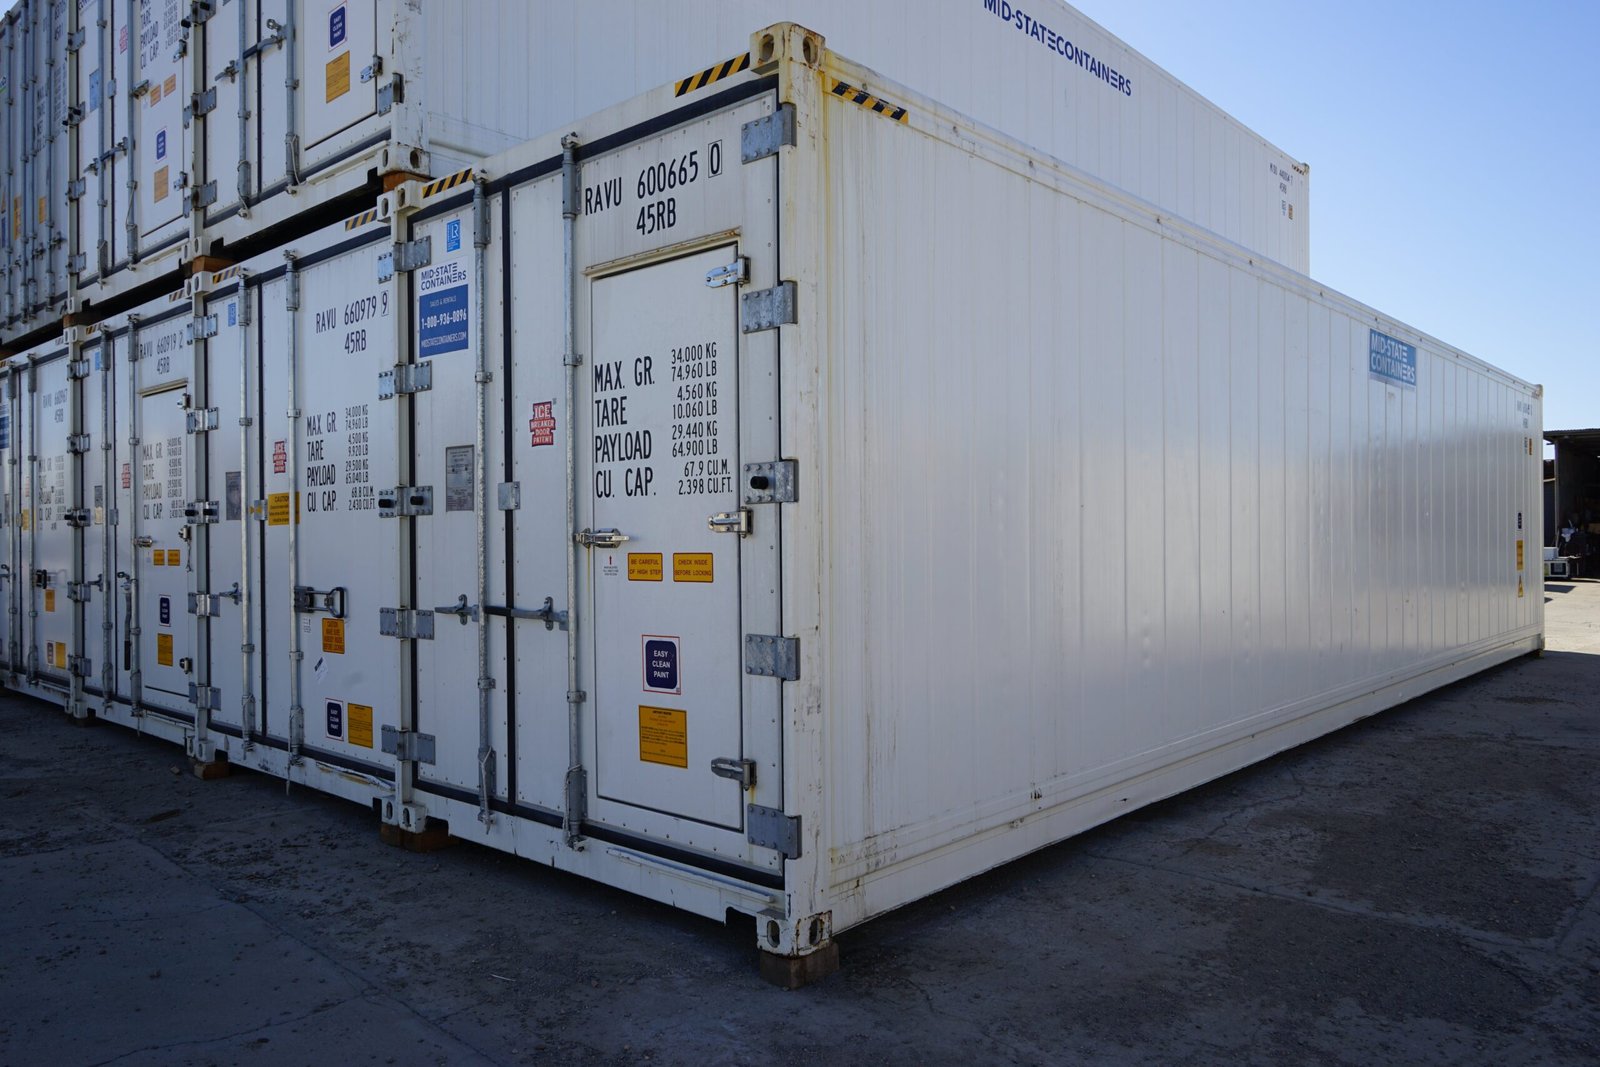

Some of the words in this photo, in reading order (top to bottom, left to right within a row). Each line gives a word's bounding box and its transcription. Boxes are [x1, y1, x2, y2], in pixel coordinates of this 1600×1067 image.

[585, 177, 622, 216] RAVU
[637, 150, 699, 199] 600665
[710, 142, 721, 175] 0
[636, 197, 677, 235] 45RB
[421, 262, 458, 281] MID-STATE
[421, 270, 467, 291] CONTAINERS
[316, 307, 337, 334] RAVU
[344, 295, 377, 326] 660979
[382, 292, 388, 315] 9
[344, 329, 367, 354] 45RB
[1371, 333, 1408, 363] MID-STATE
[671, 344, 703, 364] 34.000
[705, 342, 717, 359] KG
[594, 360, 625, 393] MAX.
[634, 356, 655, 387] GR.
[671, 362, 703, 382] 74.960
[706, 360, 717, 377] LB
[1371, 352, 1416, 383] CONTAINERS
[677, 383, 703, 401] 4.560
[706, 381, 717, 398] KG
[533, 404, 551, 420] ICE
[595, 396, 628, 428] TARE
[673, 400, 704, 420] 10.060
[706, 399, 718, 416] LB
[530, 419, 555, 430] BREAKER
[535, 428, 550, 436] DOOR
[671, 422, 704, 440] 29.440
[706, 420, 718, 437] KG
[307, 440, 324, 462] TARE
[595, 430, 652, 463] PAYLOAD
[672, 439, 704, 458] 64.900
[707, 438, 718, 455] LB
[307, 464, 336, 487] PAYLOAD
[684, 460, 704, 477] 67.9
[595, 469, 615, 498] CU.
[625, 467, 657, 497] CAP.
[678, 478, 704, 495] 2.398
[693, 569, 712, 577] LOCKING
[652, 660, 671, 669] CLEAN
[653, 650, 669, 658] EASY
[653, 670, 670, 679] PAINT
